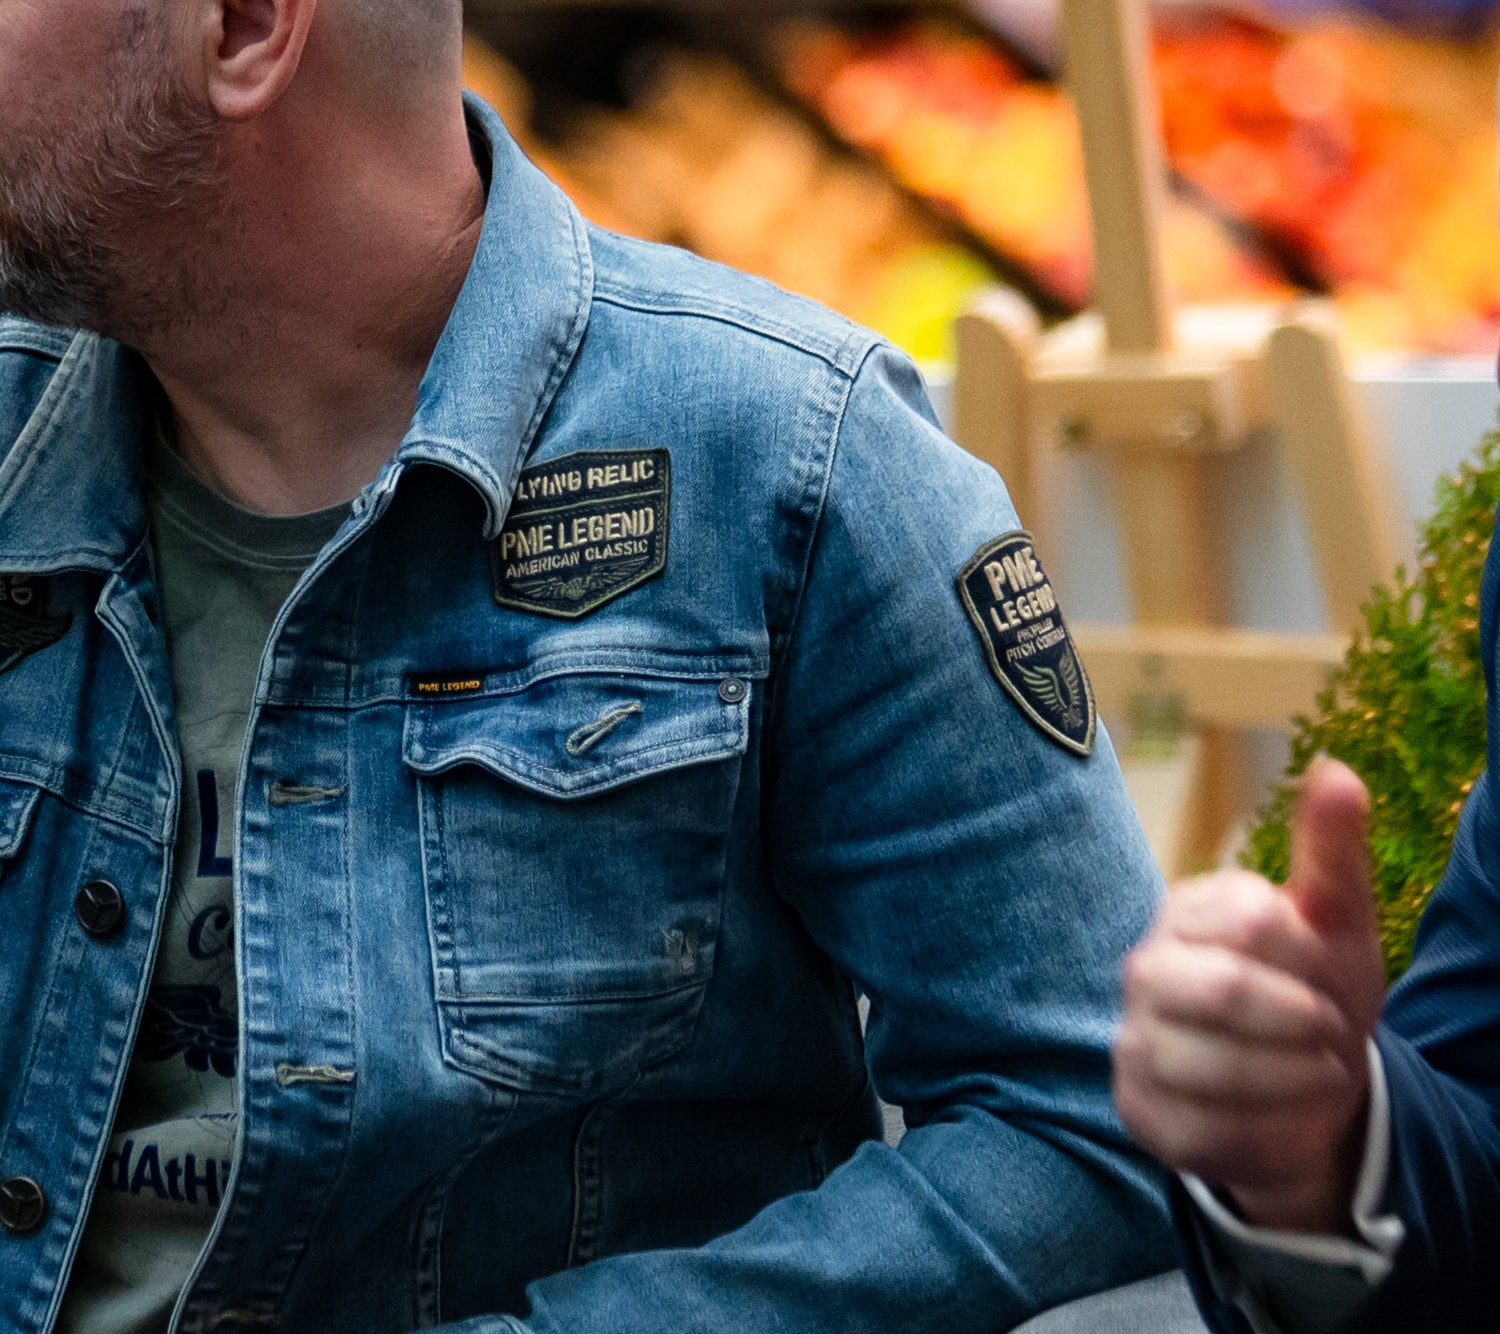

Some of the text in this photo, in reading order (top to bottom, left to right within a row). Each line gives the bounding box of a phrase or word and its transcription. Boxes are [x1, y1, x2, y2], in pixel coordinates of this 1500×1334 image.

[517, 459, 655, 500] LYING RELIC
[501, 507, 655, 560] PME LEGEND
[505, 539, 649, 579] AMERICAN CLASSIC
[984, 546, 1044, 601] PME
[418, 680, 480, 692] PME LEGEND
